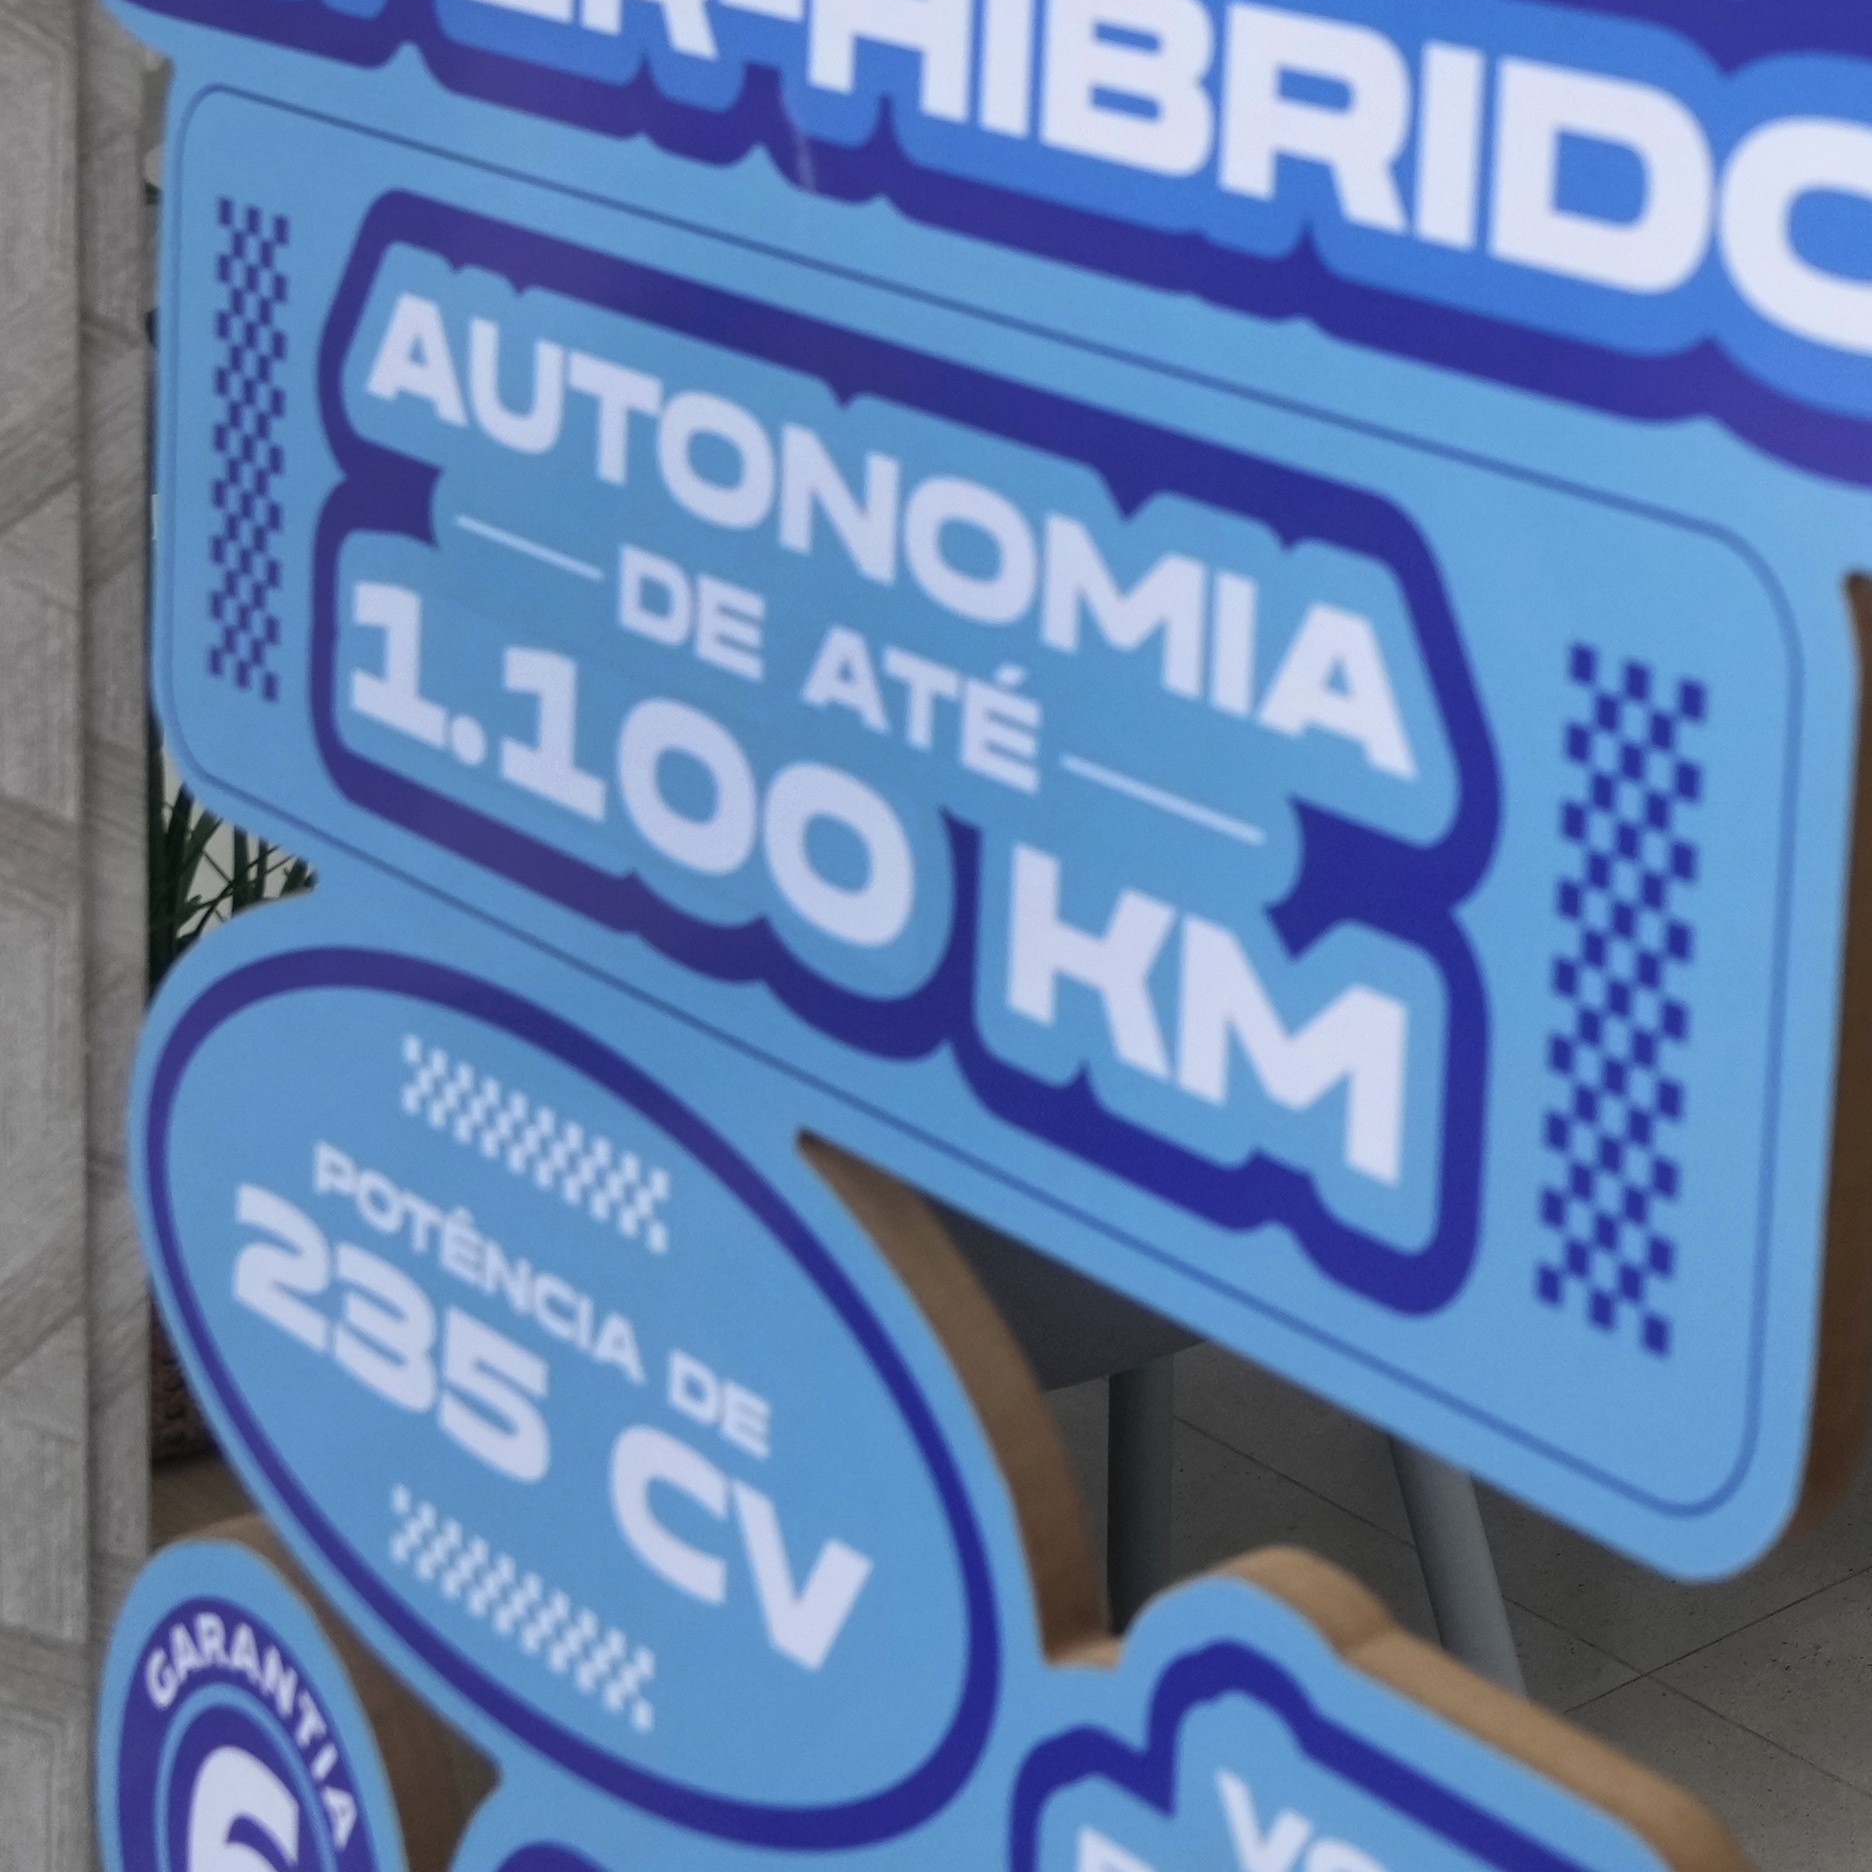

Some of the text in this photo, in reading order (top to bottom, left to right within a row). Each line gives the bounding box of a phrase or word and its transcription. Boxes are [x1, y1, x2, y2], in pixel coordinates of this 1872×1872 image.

[364, 291, 1419, 782] AUTONOMIA
[617, 545, 1043, 795] DE ATÉ
[350, 579, 1409, 1187] 1.100 KM
[232, 1182, 874, 1672] 235 CV
[312, 1138, 772, 1460] POTÊNCIA DE
[144, 1610, 358, 1854] GARANTIA
